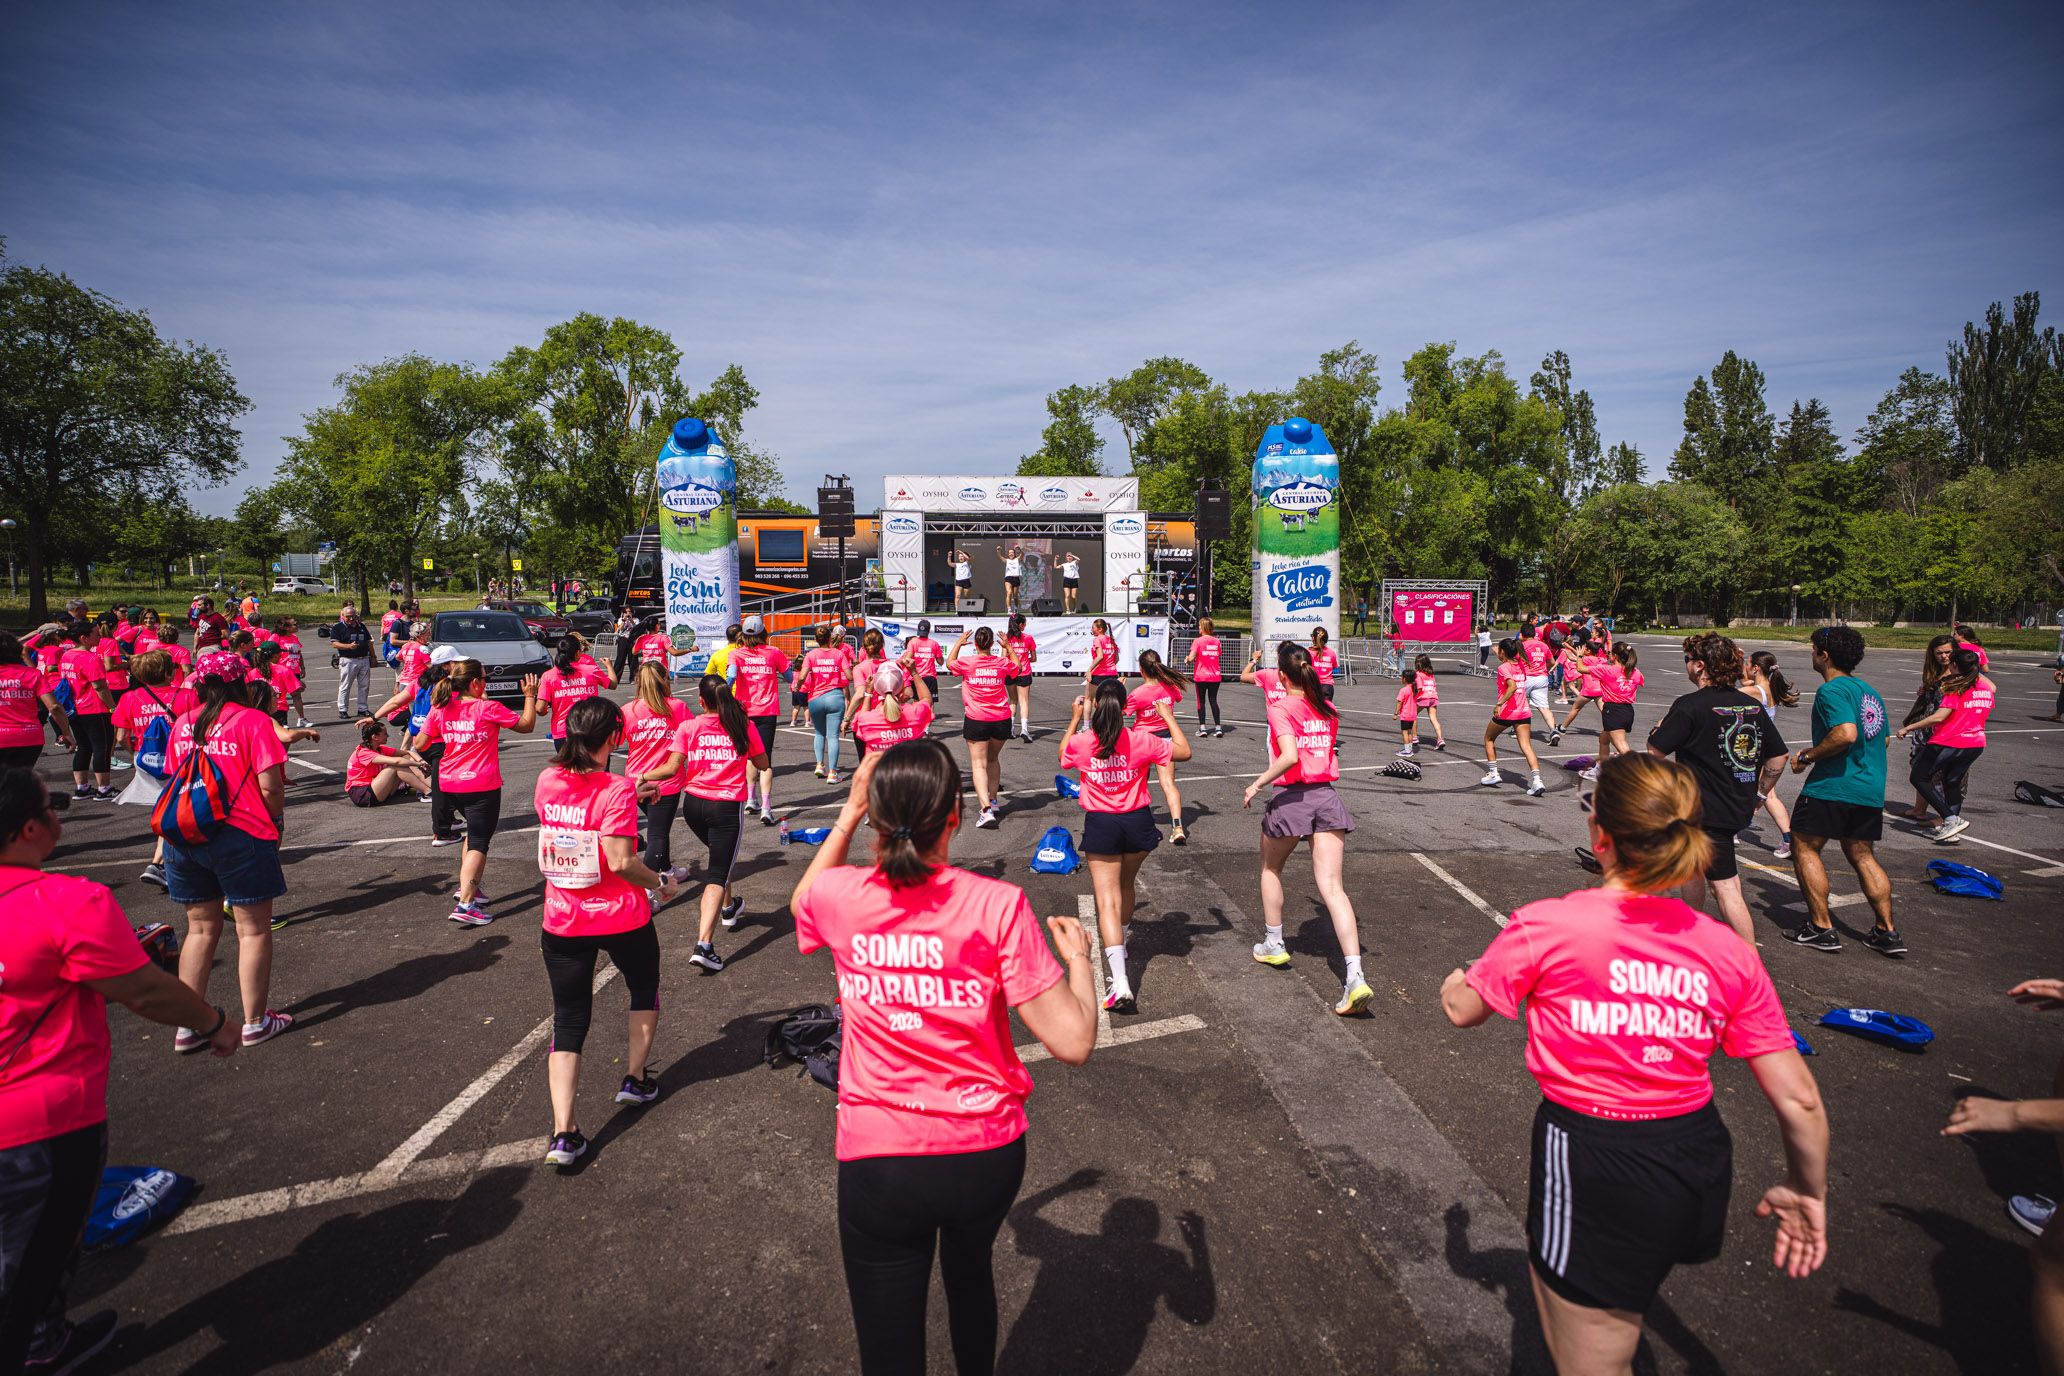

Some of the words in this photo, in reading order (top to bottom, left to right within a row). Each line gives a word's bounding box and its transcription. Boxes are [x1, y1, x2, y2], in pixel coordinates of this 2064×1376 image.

[666, 494, 718, 505] ASTURIANA
[1273, 494, 1327, 504] ASTURIANA
[669, 563, 699, 580] Leche
[1271, 563, 1287, 572] Leche
[1288, 561, 1300, 569] rica
[668, 576, 726, 600] semi
[1273, 572, 1324, 598] Calcio
[669, 599, 728, 615] desnatada
[1296, 596, 1323, 607] natural
[1275, 615, 1323, 623] semidesnatada
[0, 679, 21, 688] MOS
[561, 678, 586, 688] SOMOS
[0, 690, 34, 698] RABLES
[555, 686, 595, 698] IMPARABLES
[446, 720, 475, 731] SOMOS
[638, 718, 667, 730] SOMOS
[1303, 720, 1330, 733] SOMOS
[699, 735, 732, 746] SOMOS
[880, 728, 913, 741] SOMOS
[852, 934, 944, 970] SOMOS
[1609, 959, 1709, 1007] SOMOS
[889, 1012, 923, 1031] 2026
[1642, 1045, 1674, 1064] 2026
